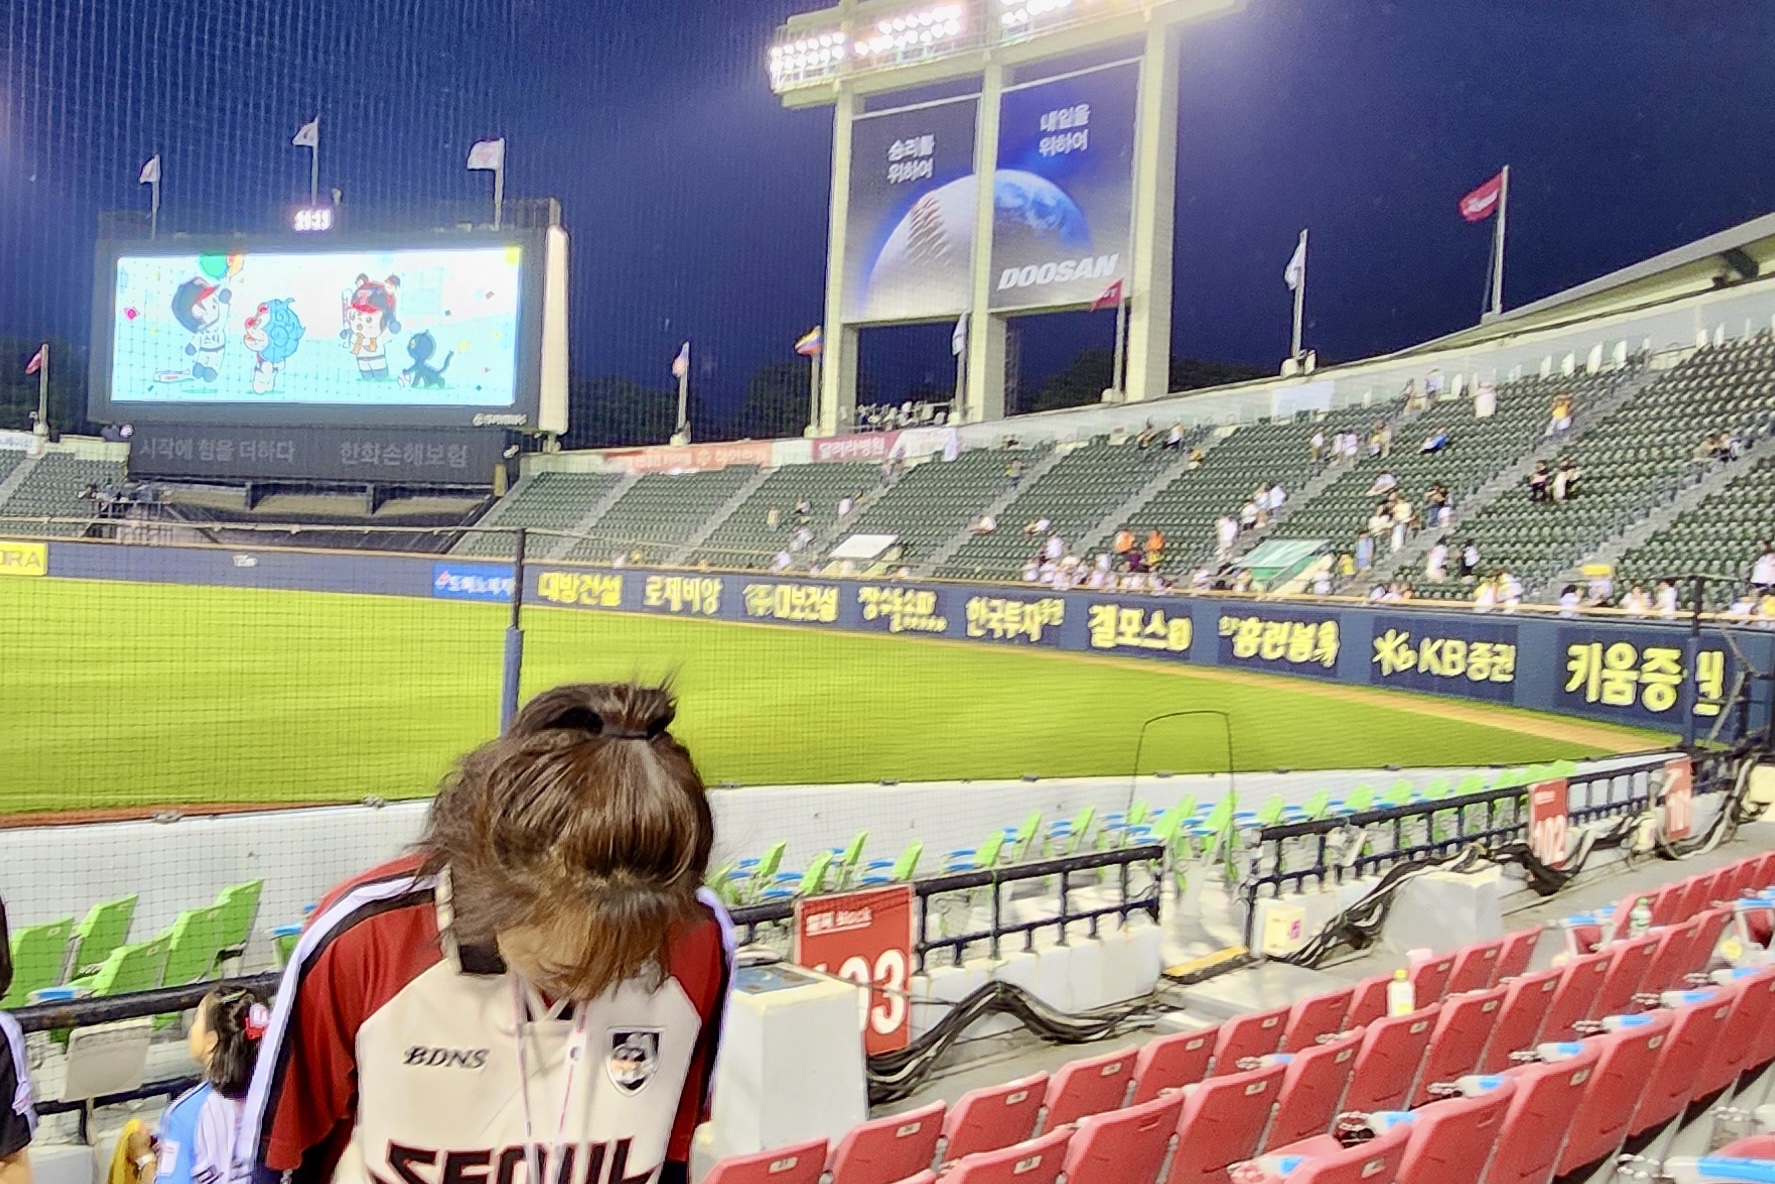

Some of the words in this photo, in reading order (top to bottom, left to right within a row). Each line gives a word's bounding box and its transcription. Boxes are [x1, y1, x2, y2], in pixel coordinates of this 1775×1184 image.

[1040, 104, 1090, 132] 내일을
[888, 134, 934, 161] 승리를
[1039, 129, 1088, 156] 위하여
[887, 158, 933, 184] 위하여
[997, 254, 1118, 291] DOOSAN
[140, 438, 193, 462] 시작에
[200, 438, 235, 463] 힘을
[239, 440, 295, 464] 더하다
[340, 441, 468, 468] 한화손해보험
[538, 571, 623, 607] 대방건설
[643, 576, 724, 615] 로제비앙
[1417, 637, 1517, 682] KB증권
[1533, 814, 1567, 866] 102
[813, 949, 905, 1036] 03
[402, 1045, 490, 1069] BDNS
